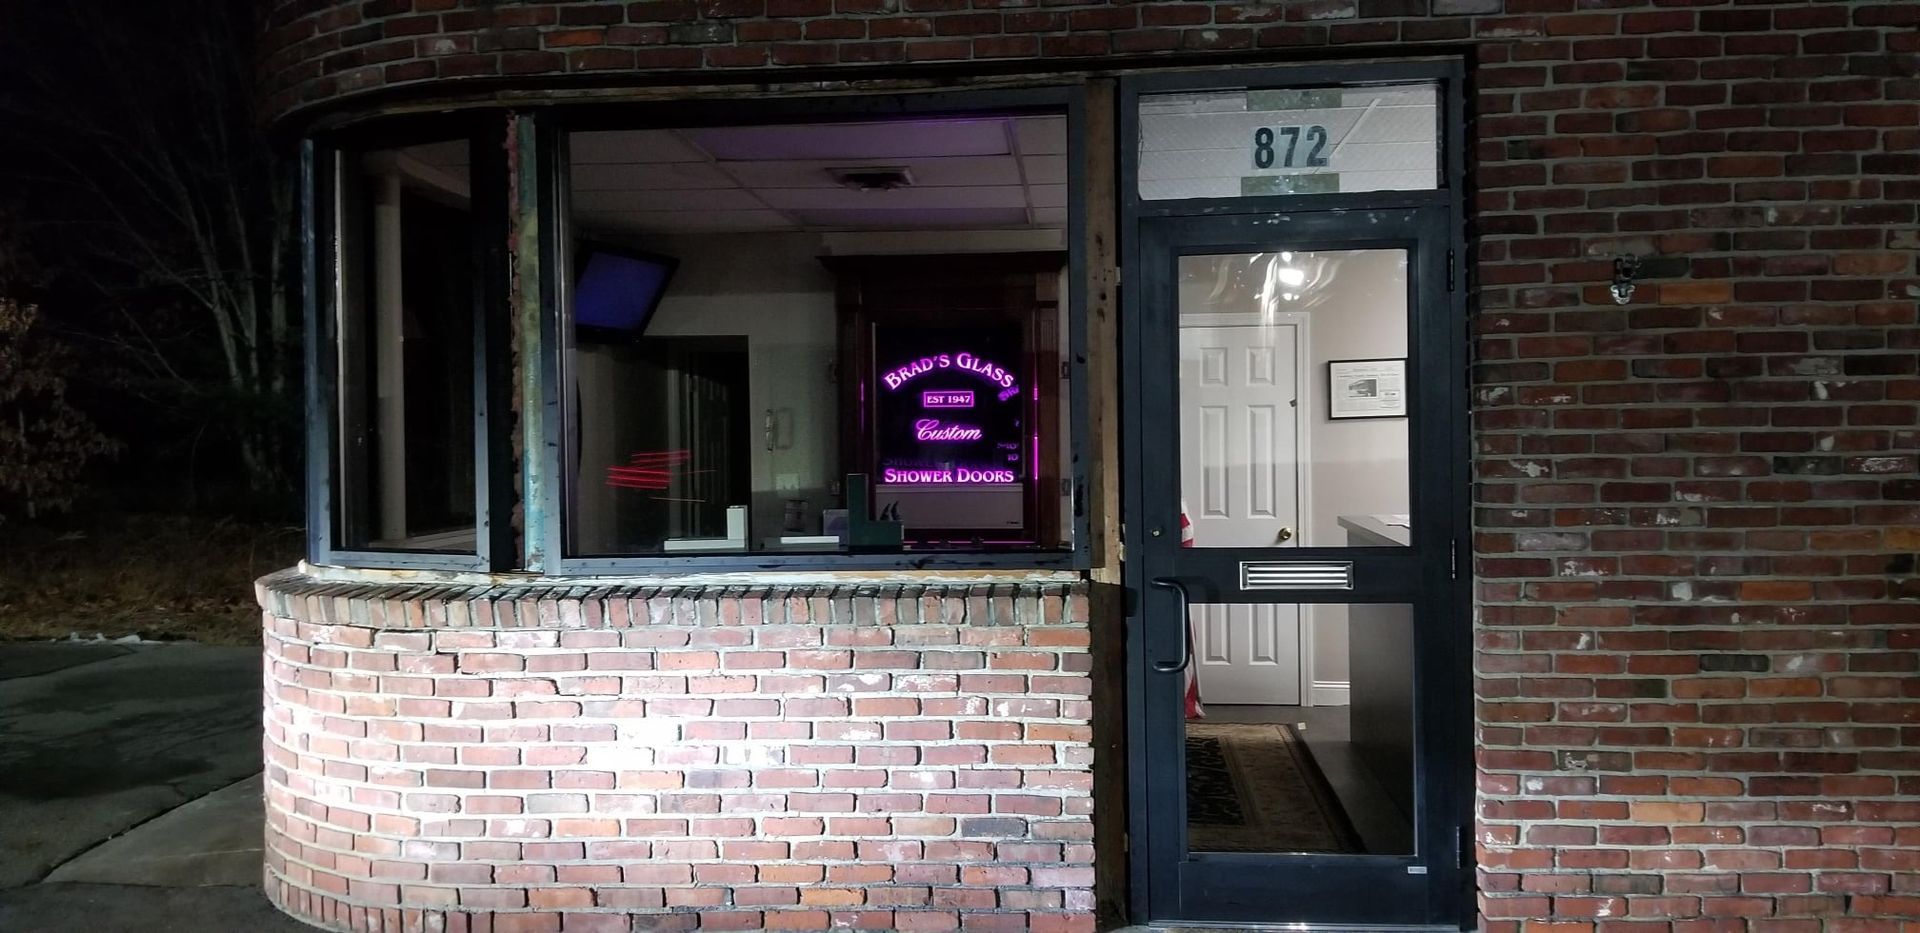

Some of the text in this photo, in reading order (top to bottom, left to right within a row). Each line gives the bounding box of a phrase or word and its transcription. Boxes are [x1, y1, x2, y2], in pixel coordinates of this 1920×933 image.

[1254, 125, 1328, 169] 872
[884, 353, 1014, 390] BRAD'S GLASS
[927, 395, 971, 404] EST 1947
[915, 419, 983, 441] Custom
[884, 468, 1014, 483] SHOWER DOORS
